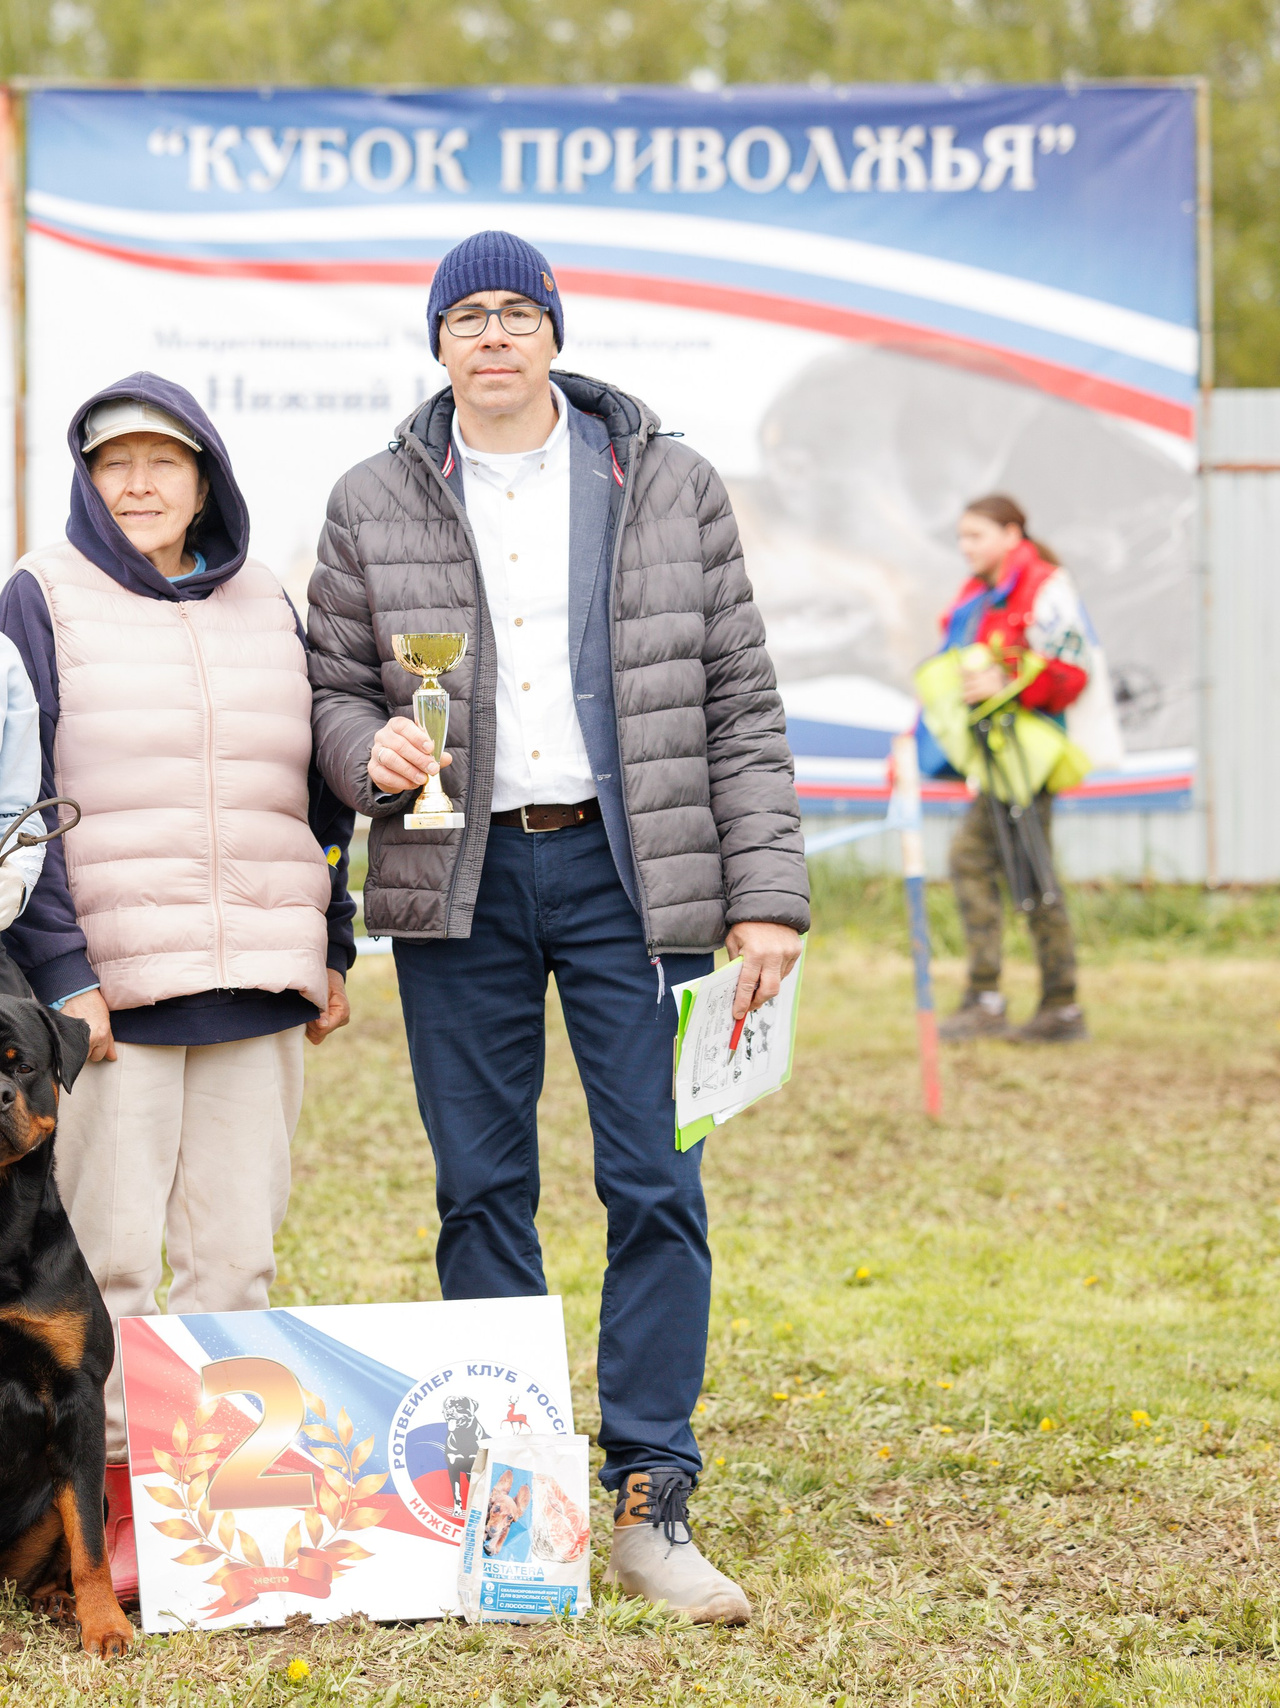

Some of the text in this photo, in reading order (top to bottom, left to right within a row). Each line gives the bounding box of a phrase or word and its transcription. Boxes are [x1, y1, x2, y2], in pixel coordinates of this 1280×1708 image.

[201, 1356, 317, 1511] 2
[393, 1369, 453, 1470] РОТВЕЙЛЕР
[466, 1365, 518, 1383] КЛУБ
[492, 1564, 545, 1576] STATERA
